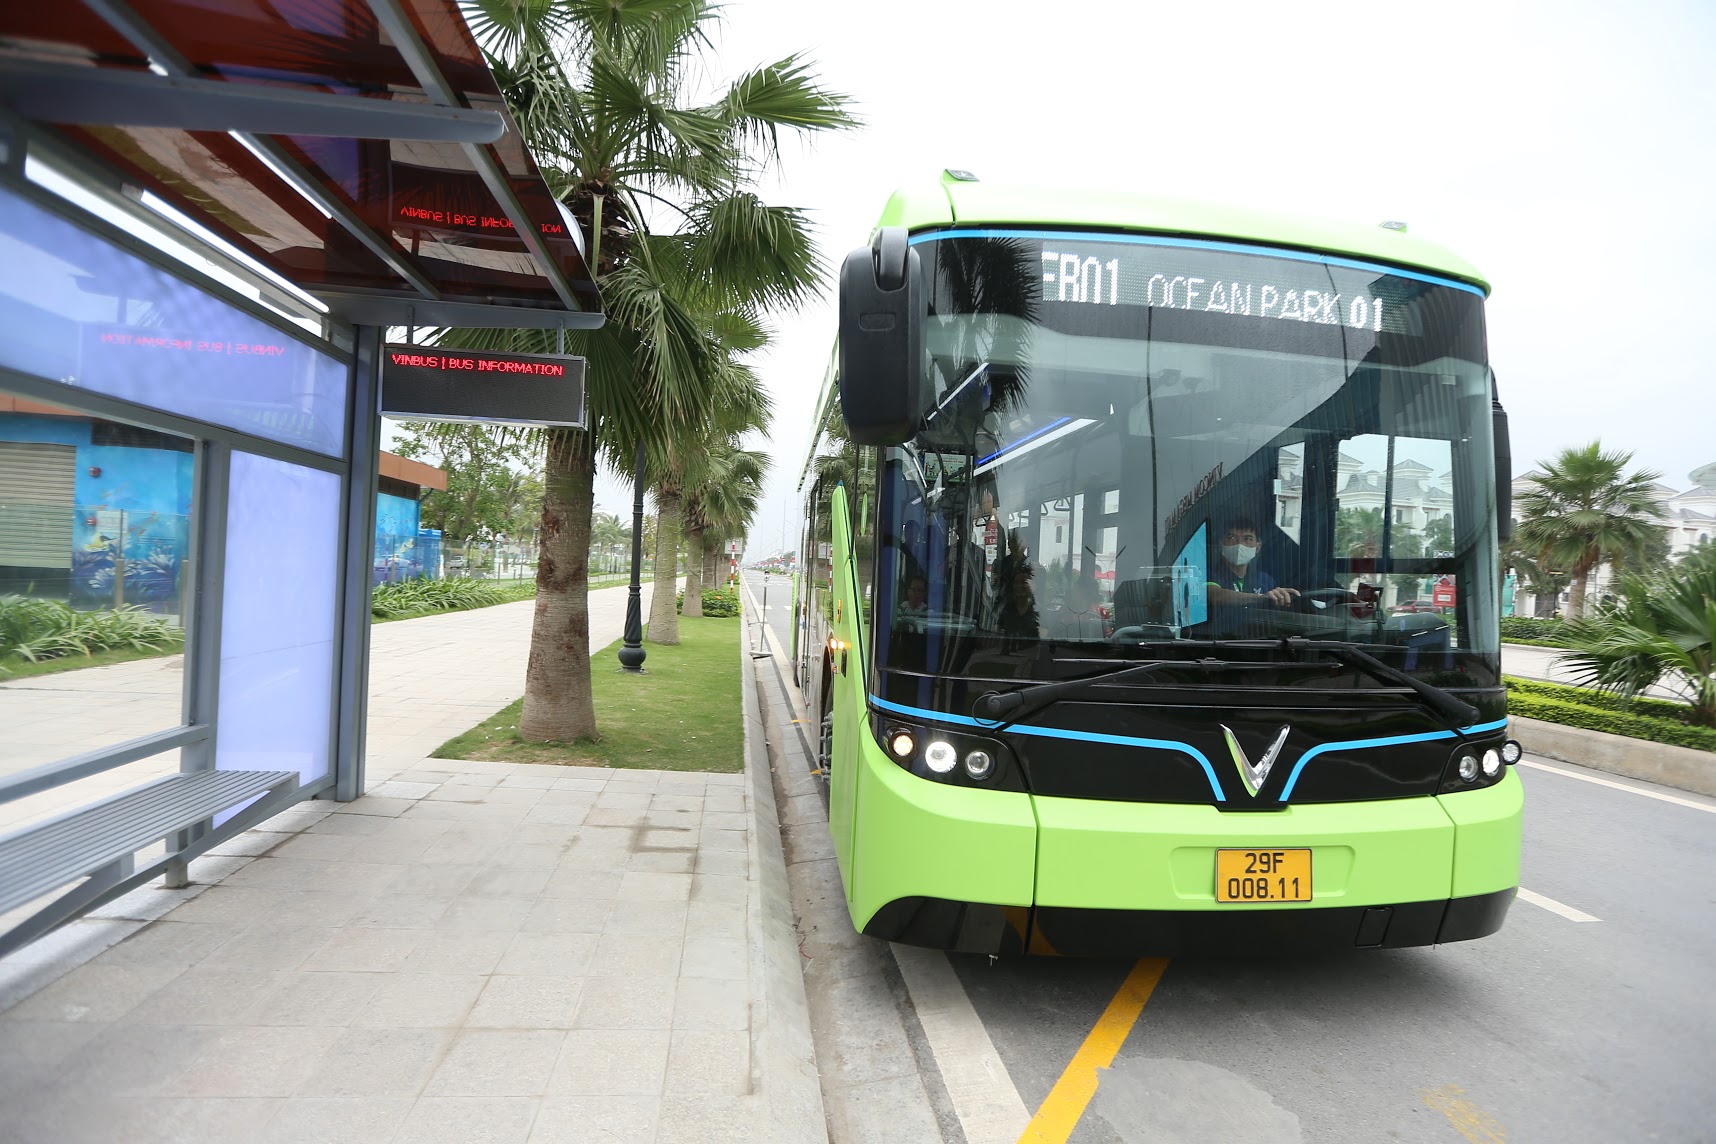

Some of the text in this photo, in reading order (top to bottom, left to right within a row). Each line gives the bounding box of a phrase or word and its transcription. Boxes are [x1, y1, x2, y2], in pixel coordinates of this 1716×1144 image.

[1260, 285, 1341, 325] PARK
[1349, 296, 1383, 332] 01
[391, 354, 438, 368] VINBUS
[449, 358, 474, 370] BUS
[478, 360, 564, 376] INFORMATION
[1245, 852, 1285, 874] 29F
[1228, 877, 1299, 899] 008.11
